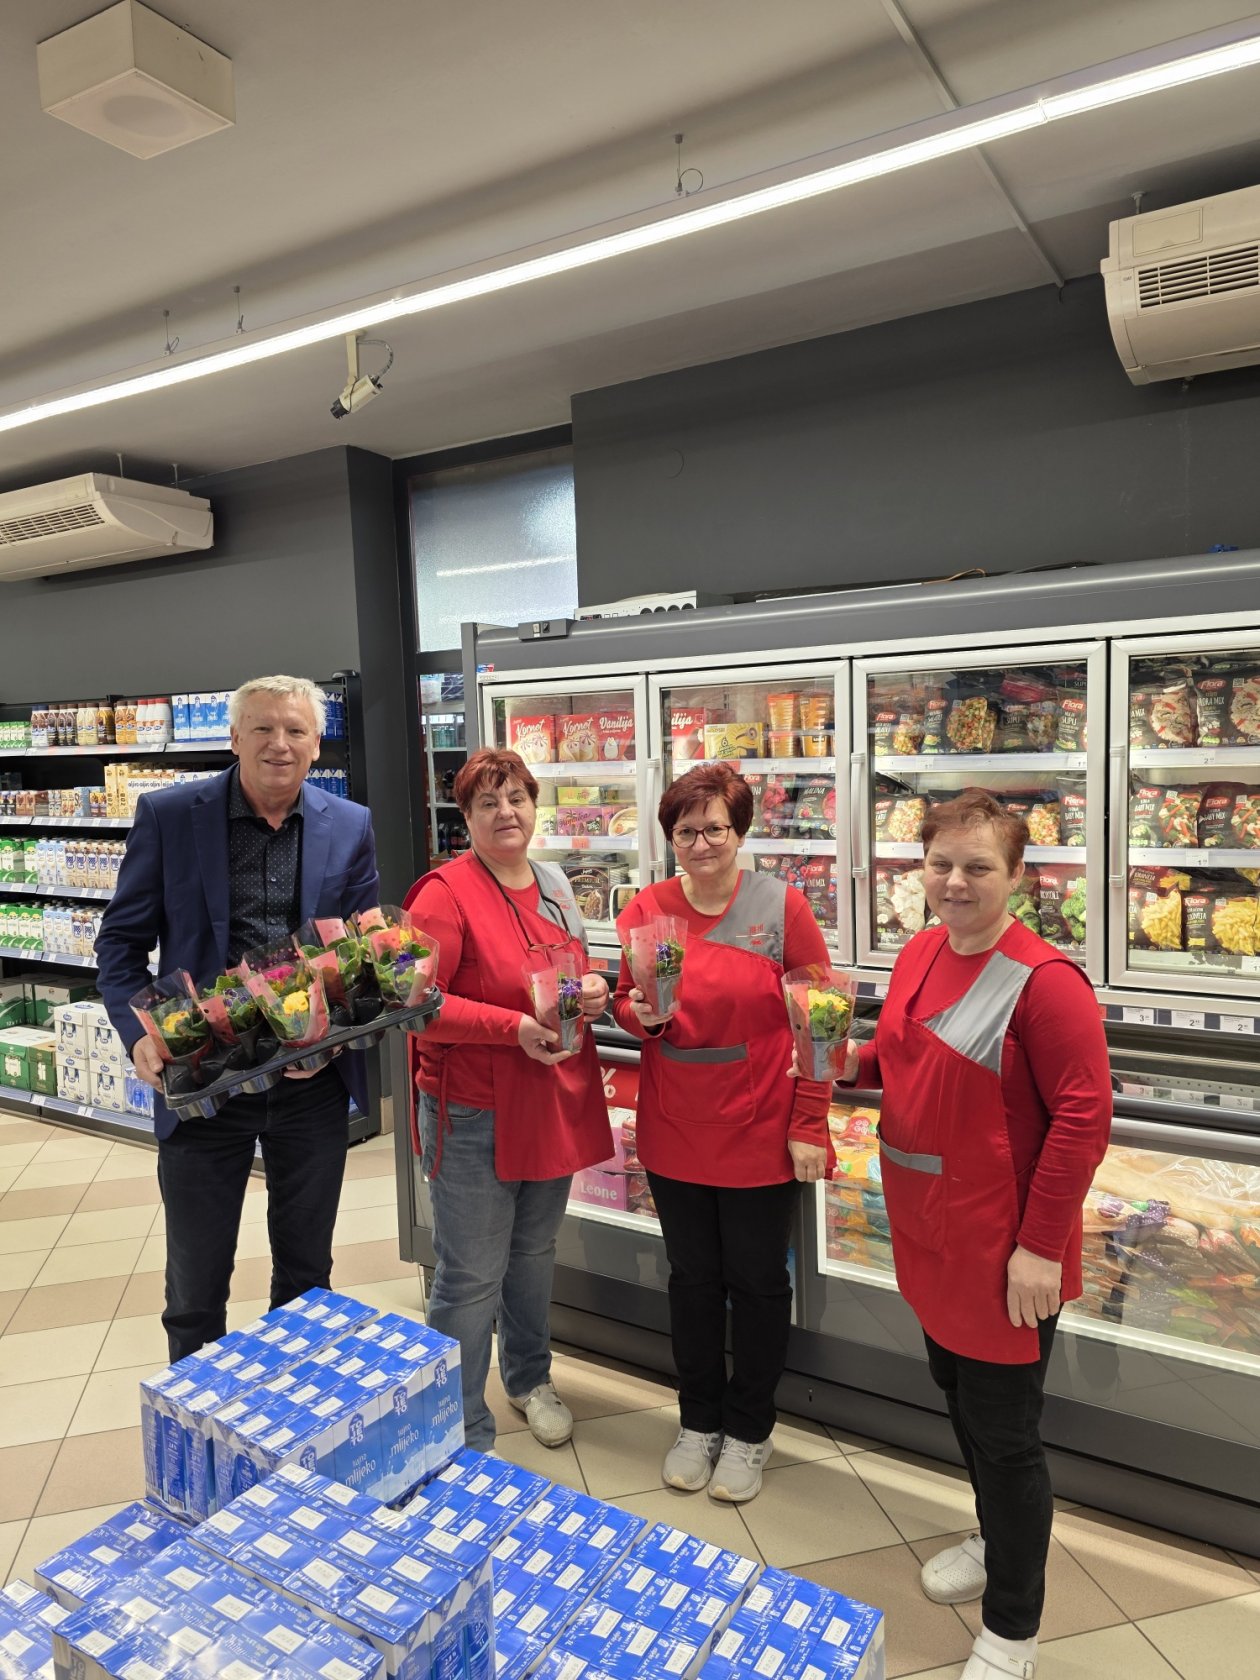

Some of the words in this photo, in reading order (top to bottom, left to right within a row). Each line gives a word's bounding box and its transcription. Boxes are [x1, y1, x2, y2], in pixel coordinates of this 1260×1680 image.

[1200, 680, 1223, 689] Flora
[1062, 700, 1084, 710] Flora
[599, 716, 634, 731] Vanilija
[1184, 897, 1206, 906] Flora
[580, 1182, 617, 1200] Leone
[435, 1363, 445, 1374] TO
[436, 1372, 445, 1381] JE
[436, 1377, 447, 1388] TO
[394, 1392, 406, 1402] TO
[395, 1399, 406, 1409] JE
[395, 1405, 407, 1416] TO
[431, 1401, 458, 1426] mlijeko
[350, 1420, 362, 1432] TO
[351, 1434, 364, 1446] TO
[352, 1429, 361, 1440] JE
[390, 1429, 419, 1456] mlijeko
[301, 1452, 315, 1464] TO
[345, 1459, 377, 1487] mlijeko
